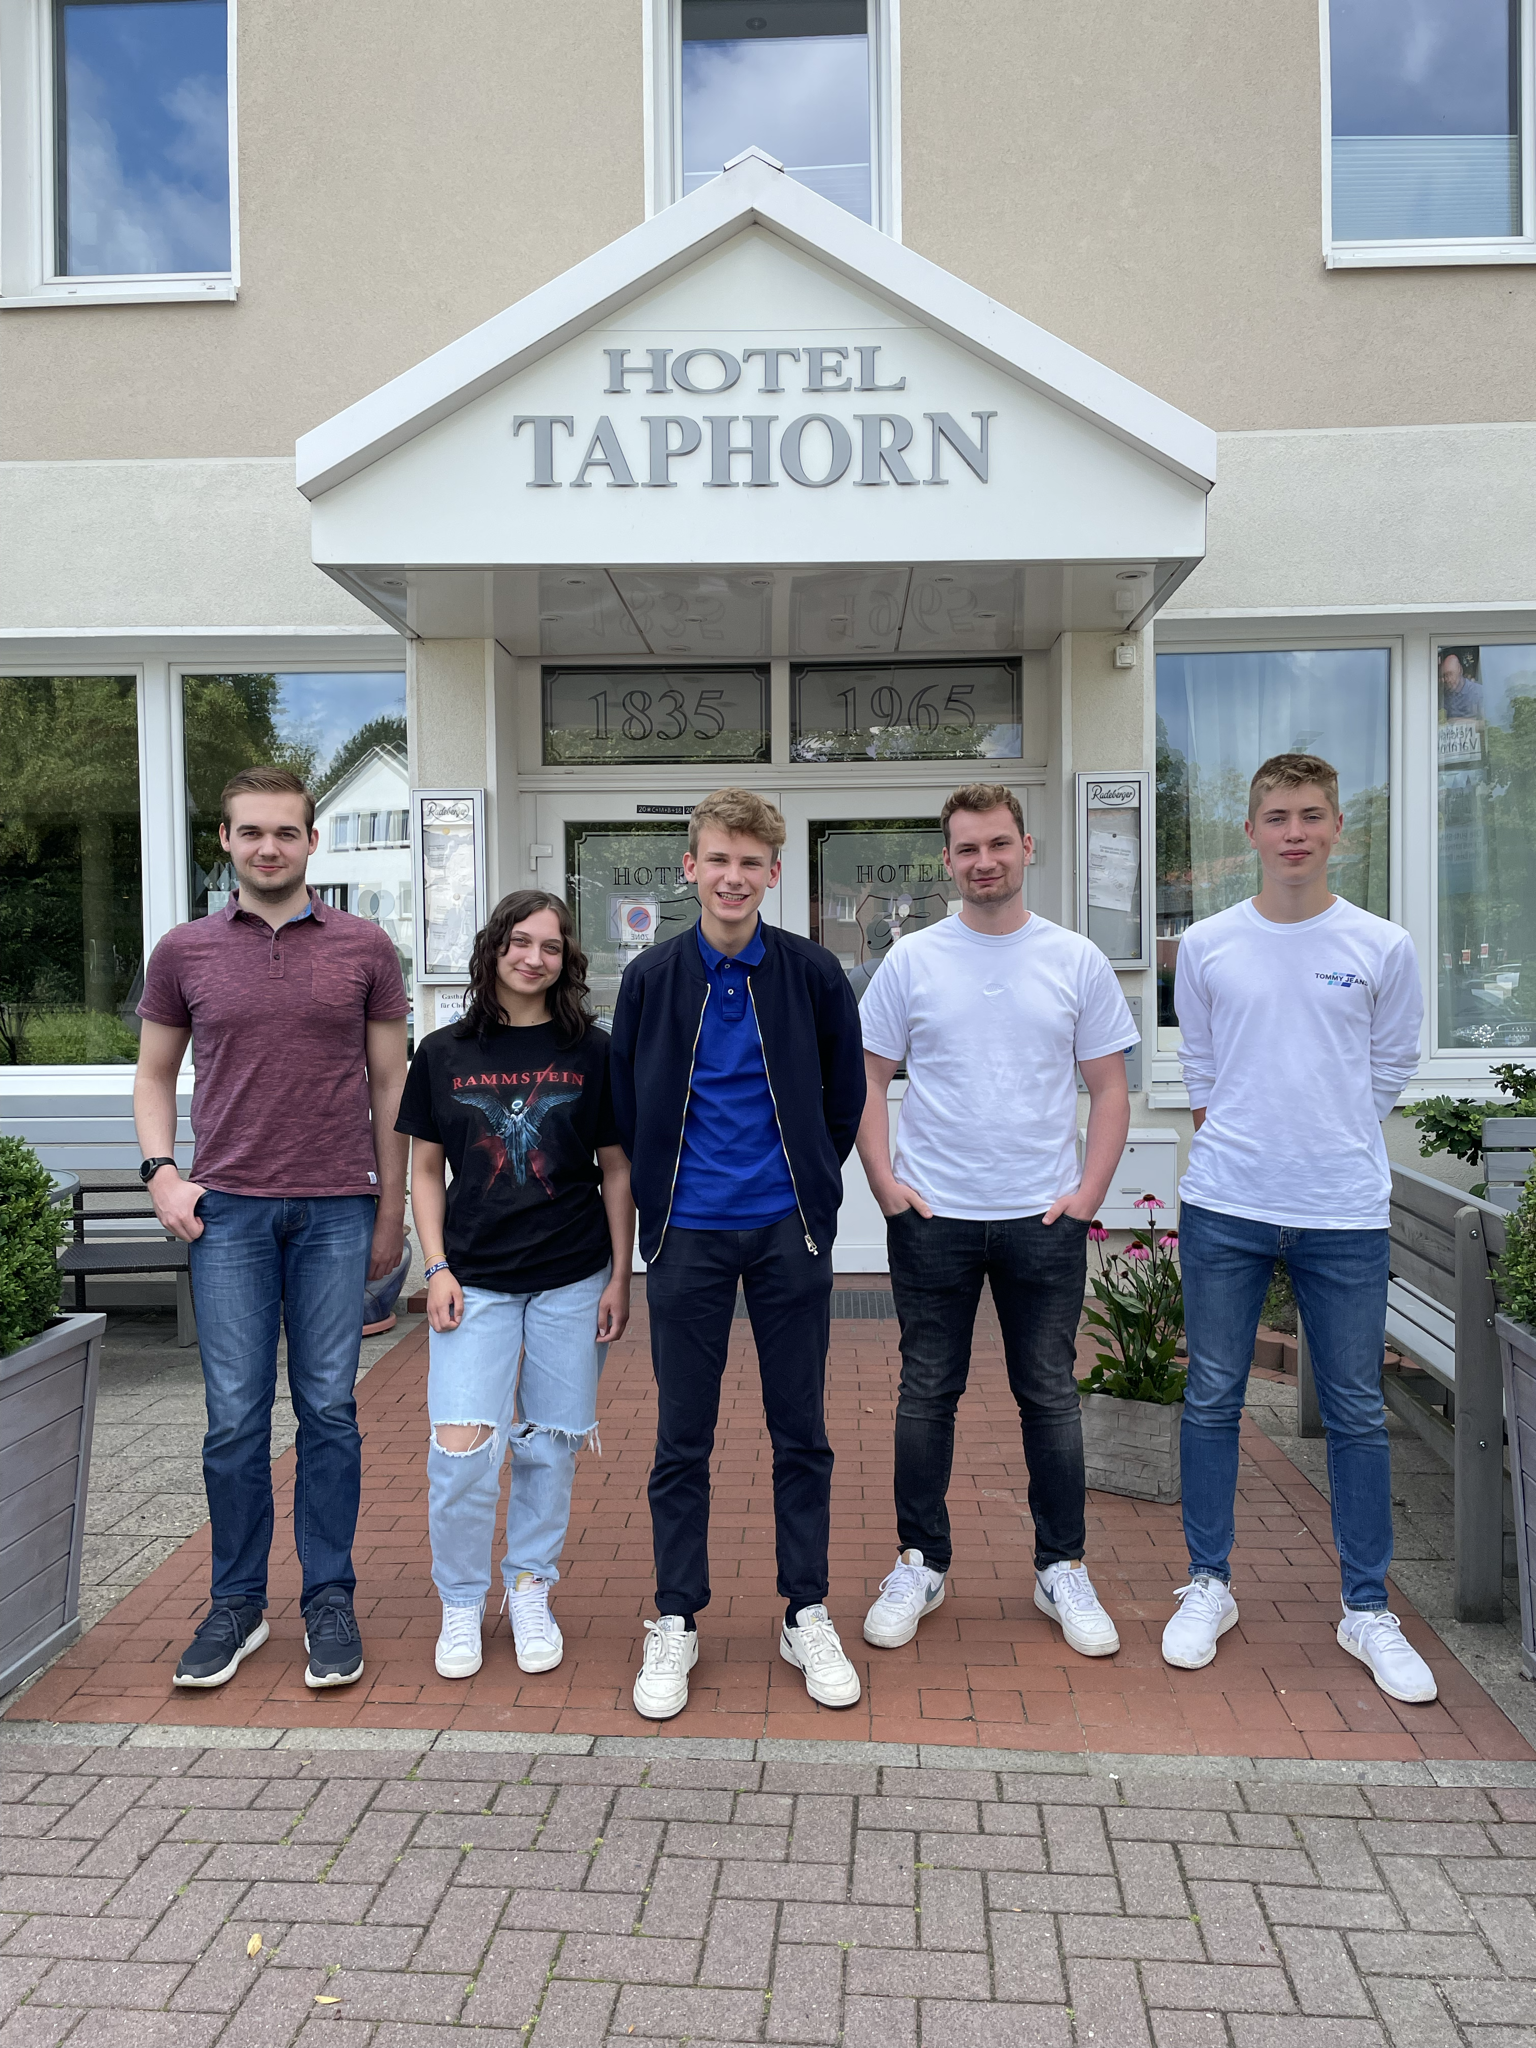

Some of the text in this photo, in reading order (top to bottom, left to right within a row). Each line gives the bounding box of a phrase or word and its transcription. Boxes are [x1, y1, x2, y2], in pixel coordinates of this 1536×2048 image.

[603, 345, 906, 394] HOTEL
[513, 410, 998, 488] TAPHORN
[588, 689, 726, 742] 1835
[838, 683, 976, 739] 1965
[1091, 785, 1136, 806] Radeberger
[613, 866, 698, 886] HOTE
[855, 864, 953, 884] HOTEL
[1314, 972, 1369, 987] TOMMY JEANS
[452, 1071, 585, 1091] RAMMSTEIN
